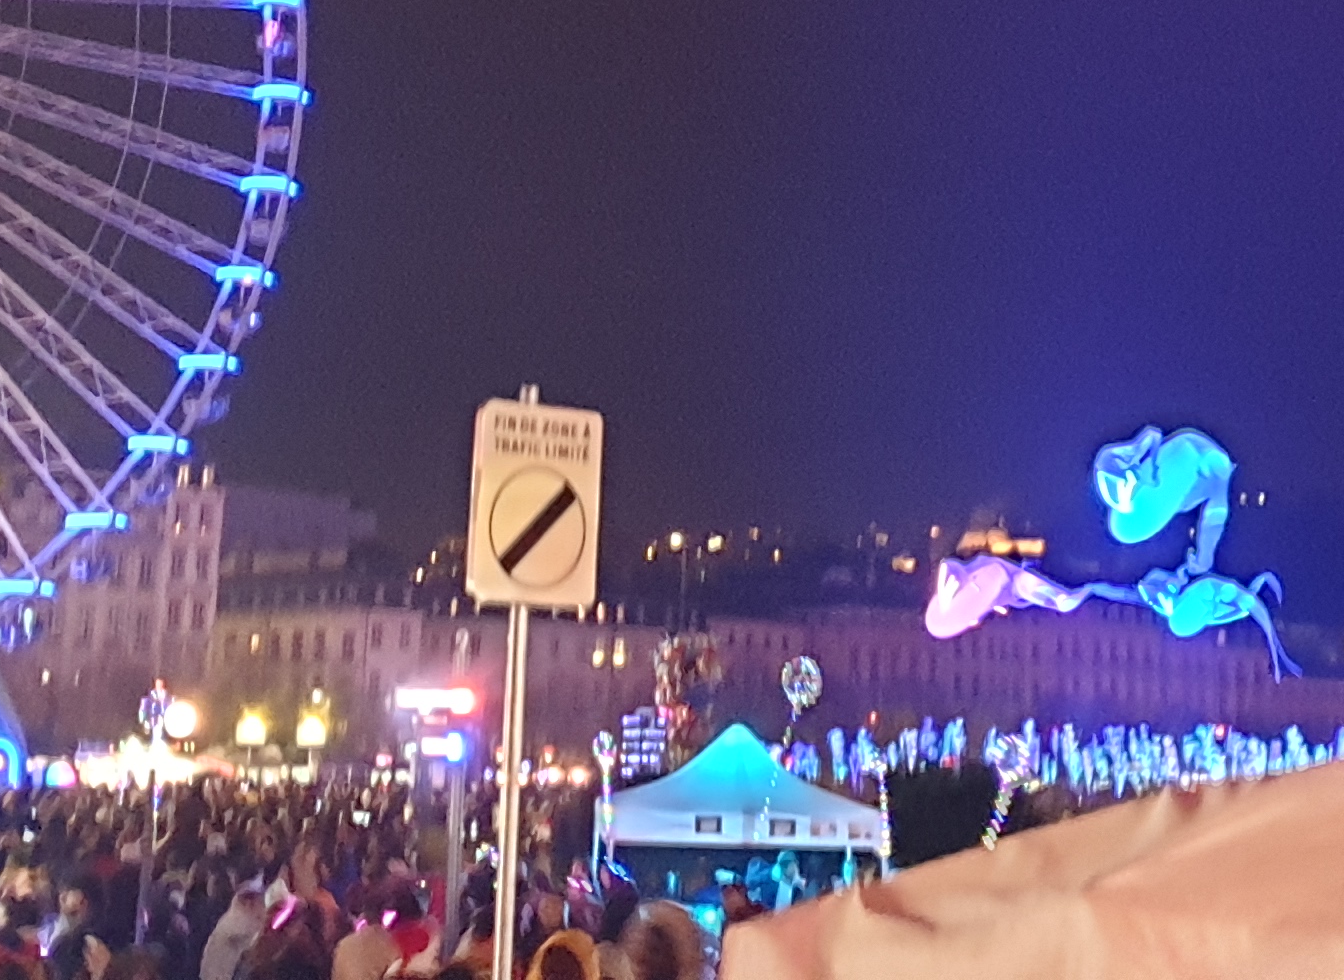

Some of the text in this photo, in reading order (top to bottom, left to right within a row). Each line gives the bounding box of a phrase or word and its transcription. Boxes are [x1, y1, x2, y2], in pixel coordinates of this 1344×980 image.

[494, 414, 516, 432] FIN
[520, 415, 537, 433] DE
[542, 418, 577, 438] ZONE
[494, 435, 540, 456] TRAFIC
